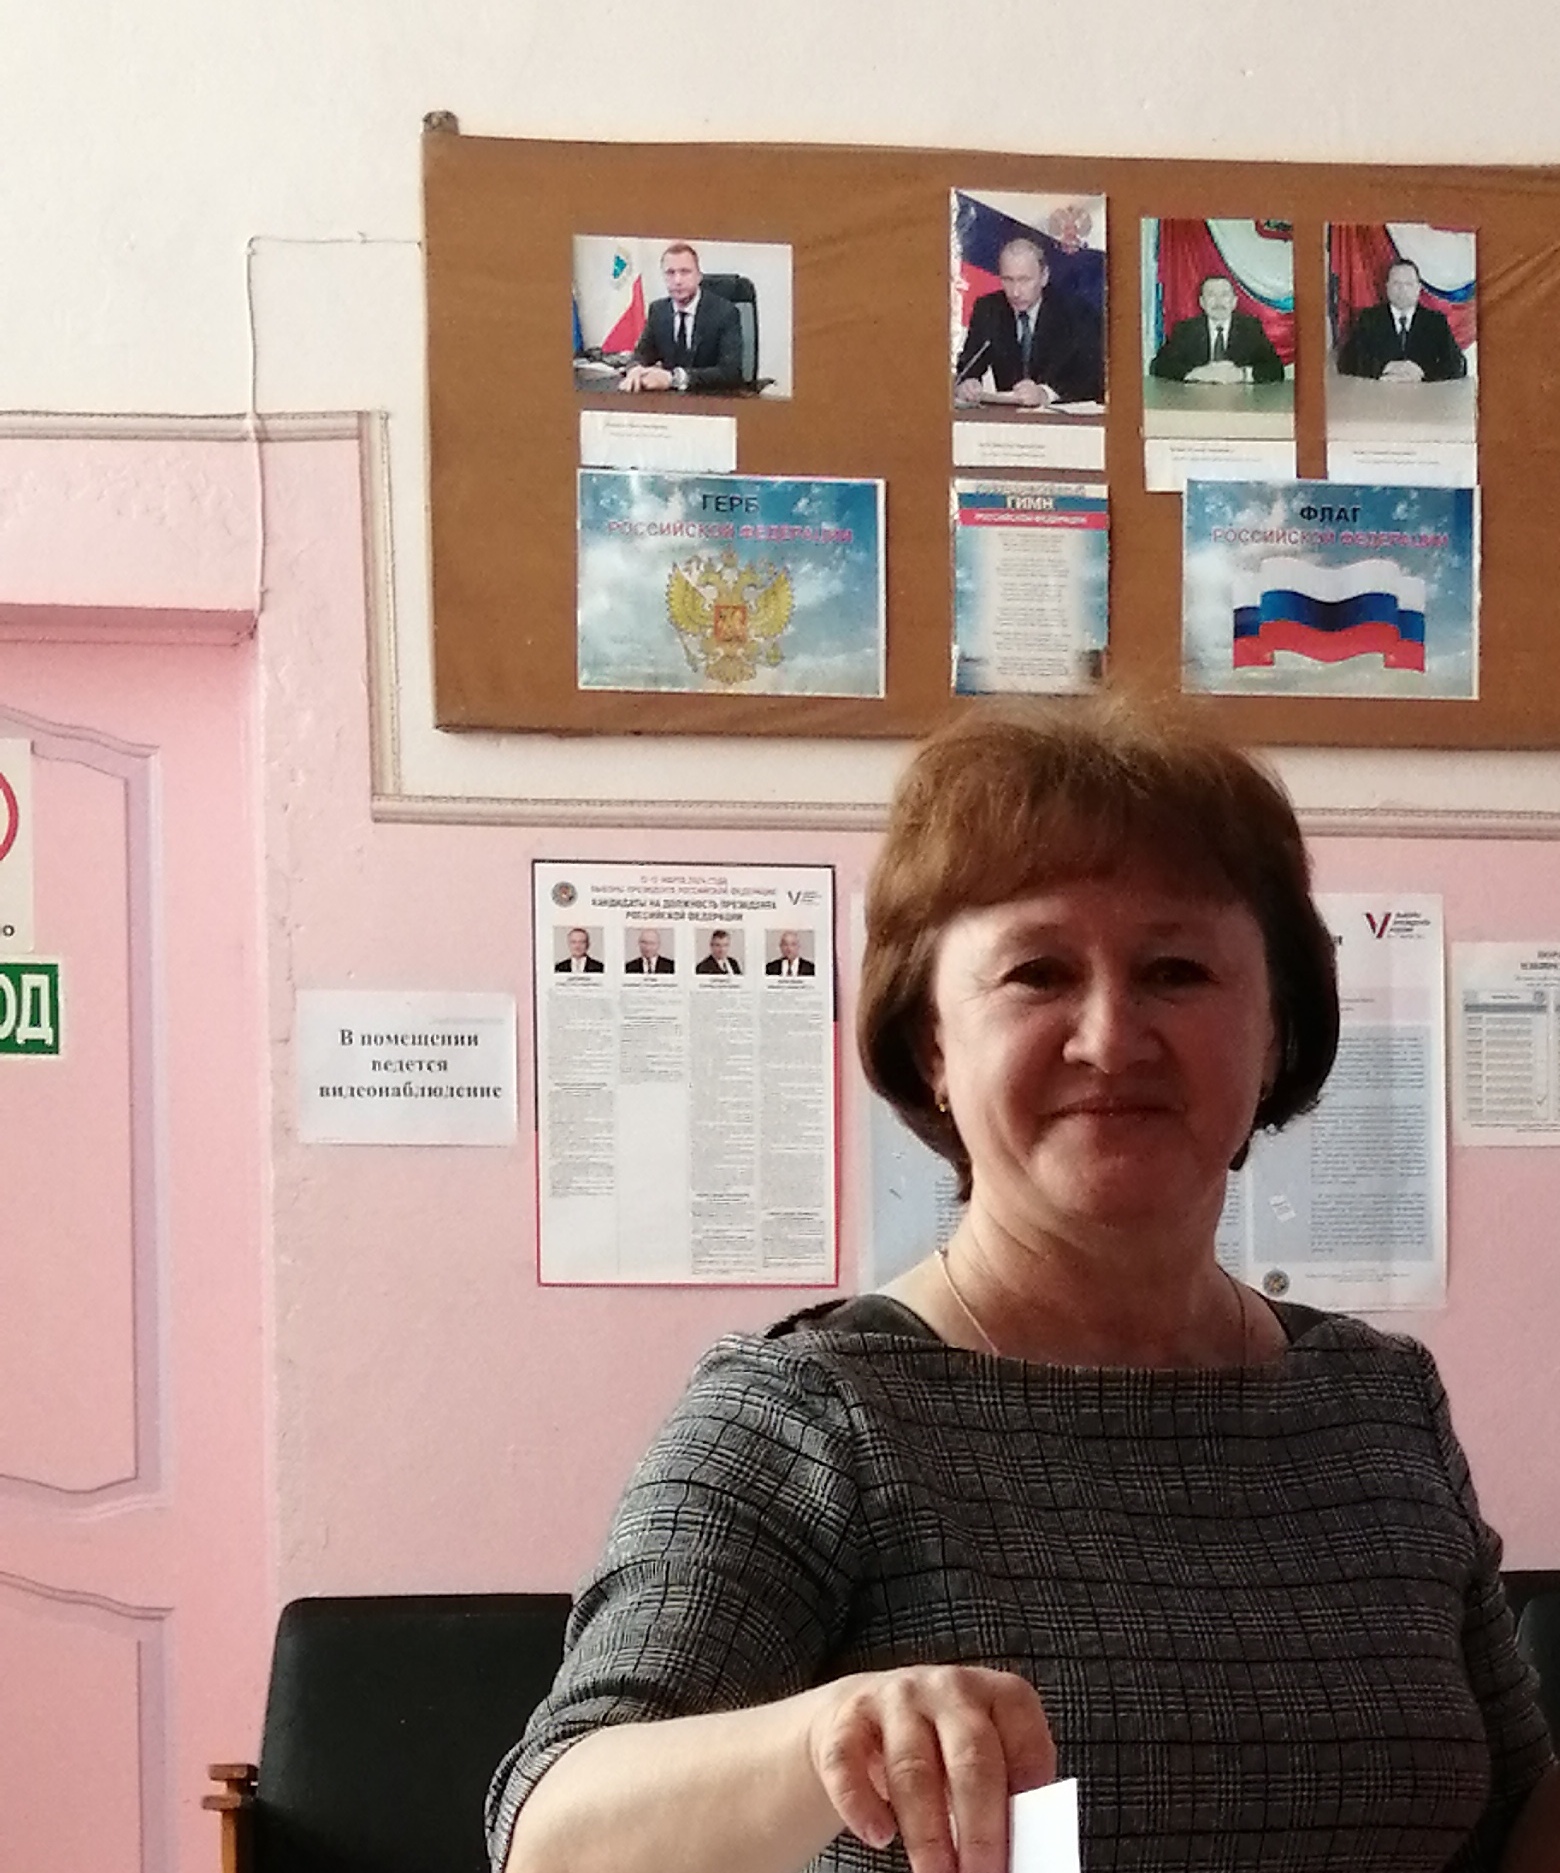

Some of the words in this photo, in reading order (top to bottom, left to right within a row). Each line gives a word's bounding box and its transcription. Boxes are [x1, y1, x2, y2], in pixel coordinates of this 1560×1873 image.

[701, 493, 760, 513] ГЕРБ
[1006, 496, 1055, 511] ГИМН
[1299, 505, 1361, 524] ФЛАГ
[608, 520, 734, 539] РОССИЙСКОЙ
[739, 525, 853, 544] ФЕДЕРАЦИИ
[1213, 528, 1336, 546] РОССИЙСКОЙ
[1341, 530, 1449, 549] ФЕДЕРАЦИИ
[340, 1029, 354, 1046] В
[361, 1033, 479, 1048] помещении
[372, 1058, 448, 1073] ведется
[319, 1082, 502, 1099] видеонаблюдение
